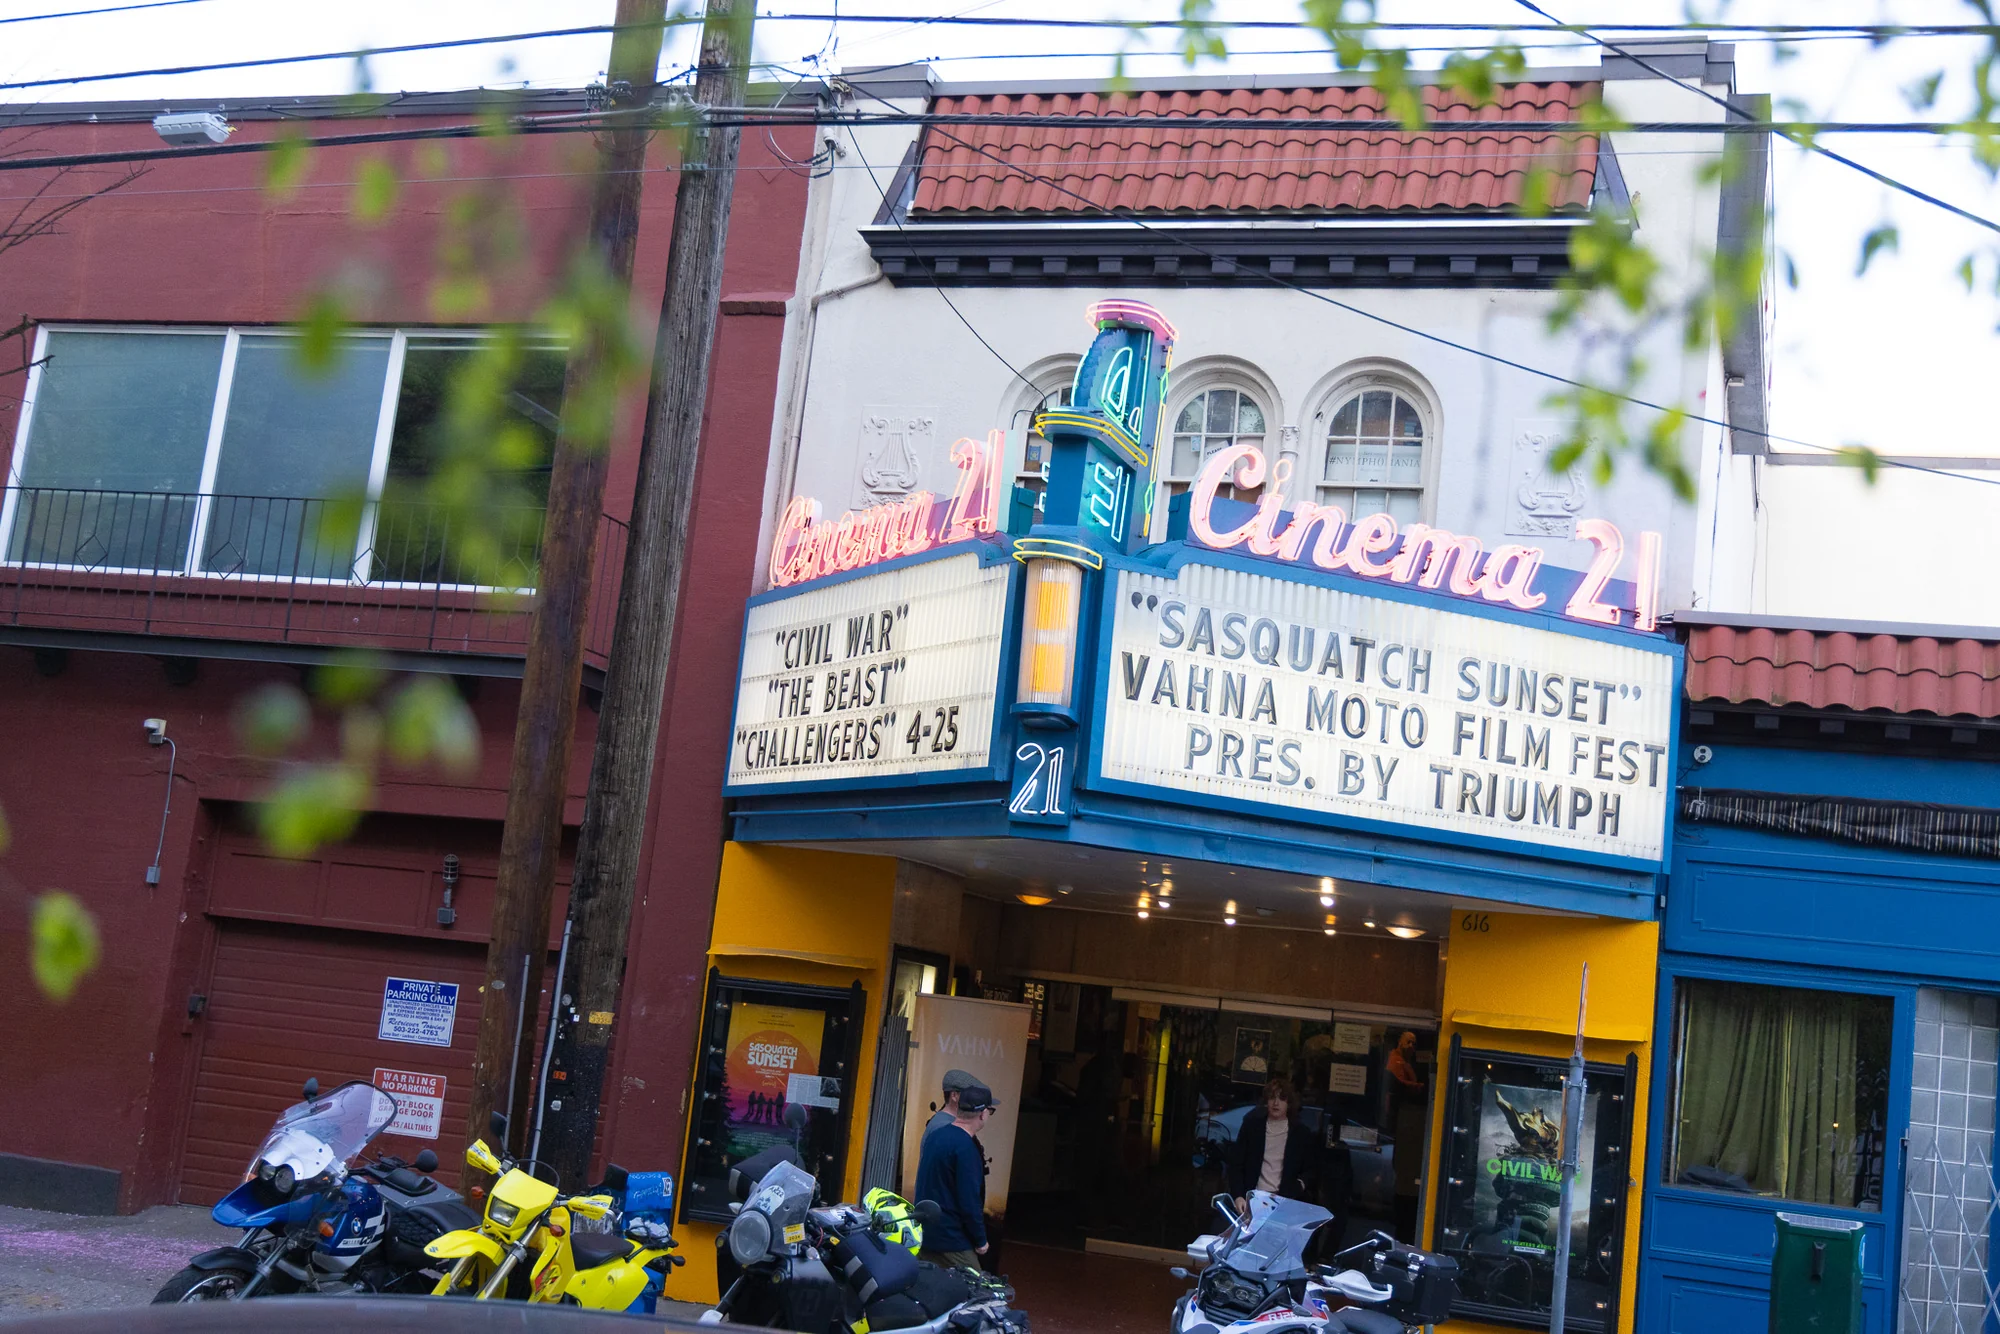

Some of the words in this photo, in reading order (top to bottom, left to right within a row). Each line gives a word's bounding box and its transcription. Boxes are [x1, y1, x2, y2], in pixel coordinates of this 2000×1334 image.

[770, 494, 936, 587] Cinema
[938, 429, 1005, 543] 21
[1190, 443, 1546, 608] Cinema
[1566, 519, 1662, 631] 21
[775, 629, 833, 670] "CIVIL
[846, 604, 910, 658] WAR"
[1130, 591, 1432, 695] "SASQUATCH
[1457, 656, 1642, 725] SUNSET"
[768, 674, 813, 719] "THE
[824, 657, 906, 709] BEAST"
[1120, 650, 1278, 725] VAHNA
[1305, 685, 1428, 748] MOTO
[1453, 712, 1550, 771] FILM
[1570, 734, 1666, 788] FEST
[736, 713, 897, 770] "CHALLENGERS"
[906, 706, 960, 755] 4-25
[1008, 742, 1066, 815] 21
[1184, 723, 1316, 790] PRES.
[1338, 750, 1400, 802] BY
[1429, 764, 1622, 837] TRIUMPH
[1462, 913, 1490, 933] 616
[387, 989, 428, 1002] PARKING
[430, 994, 455, 1005] ONLY
[403, 982, 441, 994] PRIVATE
[388, 1018, 419, 1027] Retriever
[421, 1021, 446, 1032] Towing
[749, 1042, 798, 1056] SASQUATCH
[747, 1051, 797, 1069] SUNSET
[382, 1081, 395, 1090] NO
[396, 1083, 435, 1095] PARKING
[383, 1072, 437, 1086] WARNING
[408, 1101, 435, 1110] BLOCK
[411, 1110, 434, 1118] DOOR
[404, 1122, 414, 1130] ALL
[415, 1124, 432, 1132] TIMES
[1486, 1158, 1535, 1179] CIVIL
